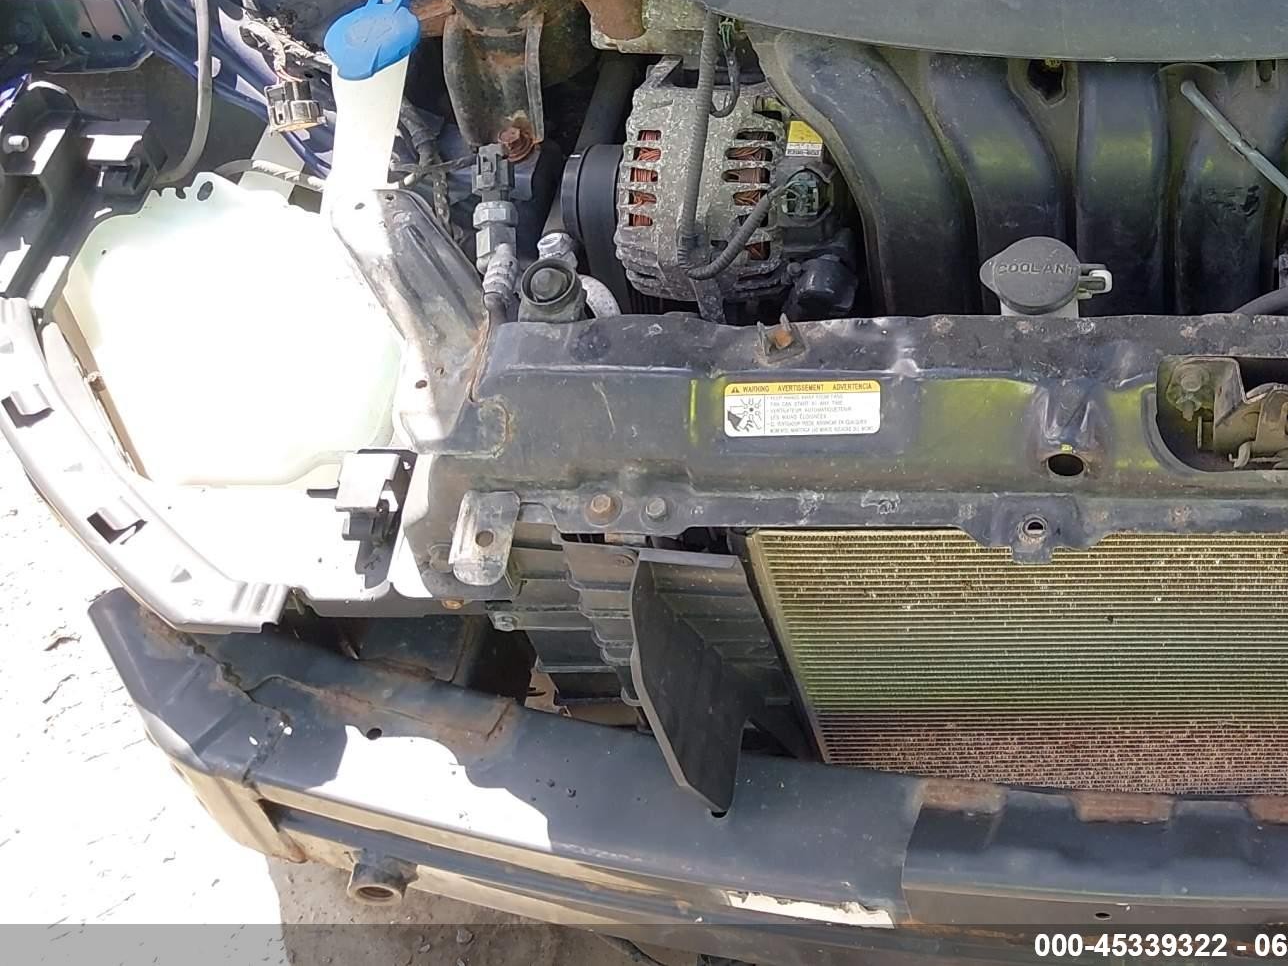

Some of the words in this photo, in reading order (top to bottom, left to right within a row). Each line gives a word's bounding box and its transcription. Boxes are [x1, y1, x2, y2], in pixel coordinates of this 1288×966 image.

[998, 262, 1074, 275] COOLANT
[743, 385, 770, 393] WARNING
[778, 384, 825, 392] AVERTISSEMENT
[833, 382, 872, 391] ADVERTENCIA
